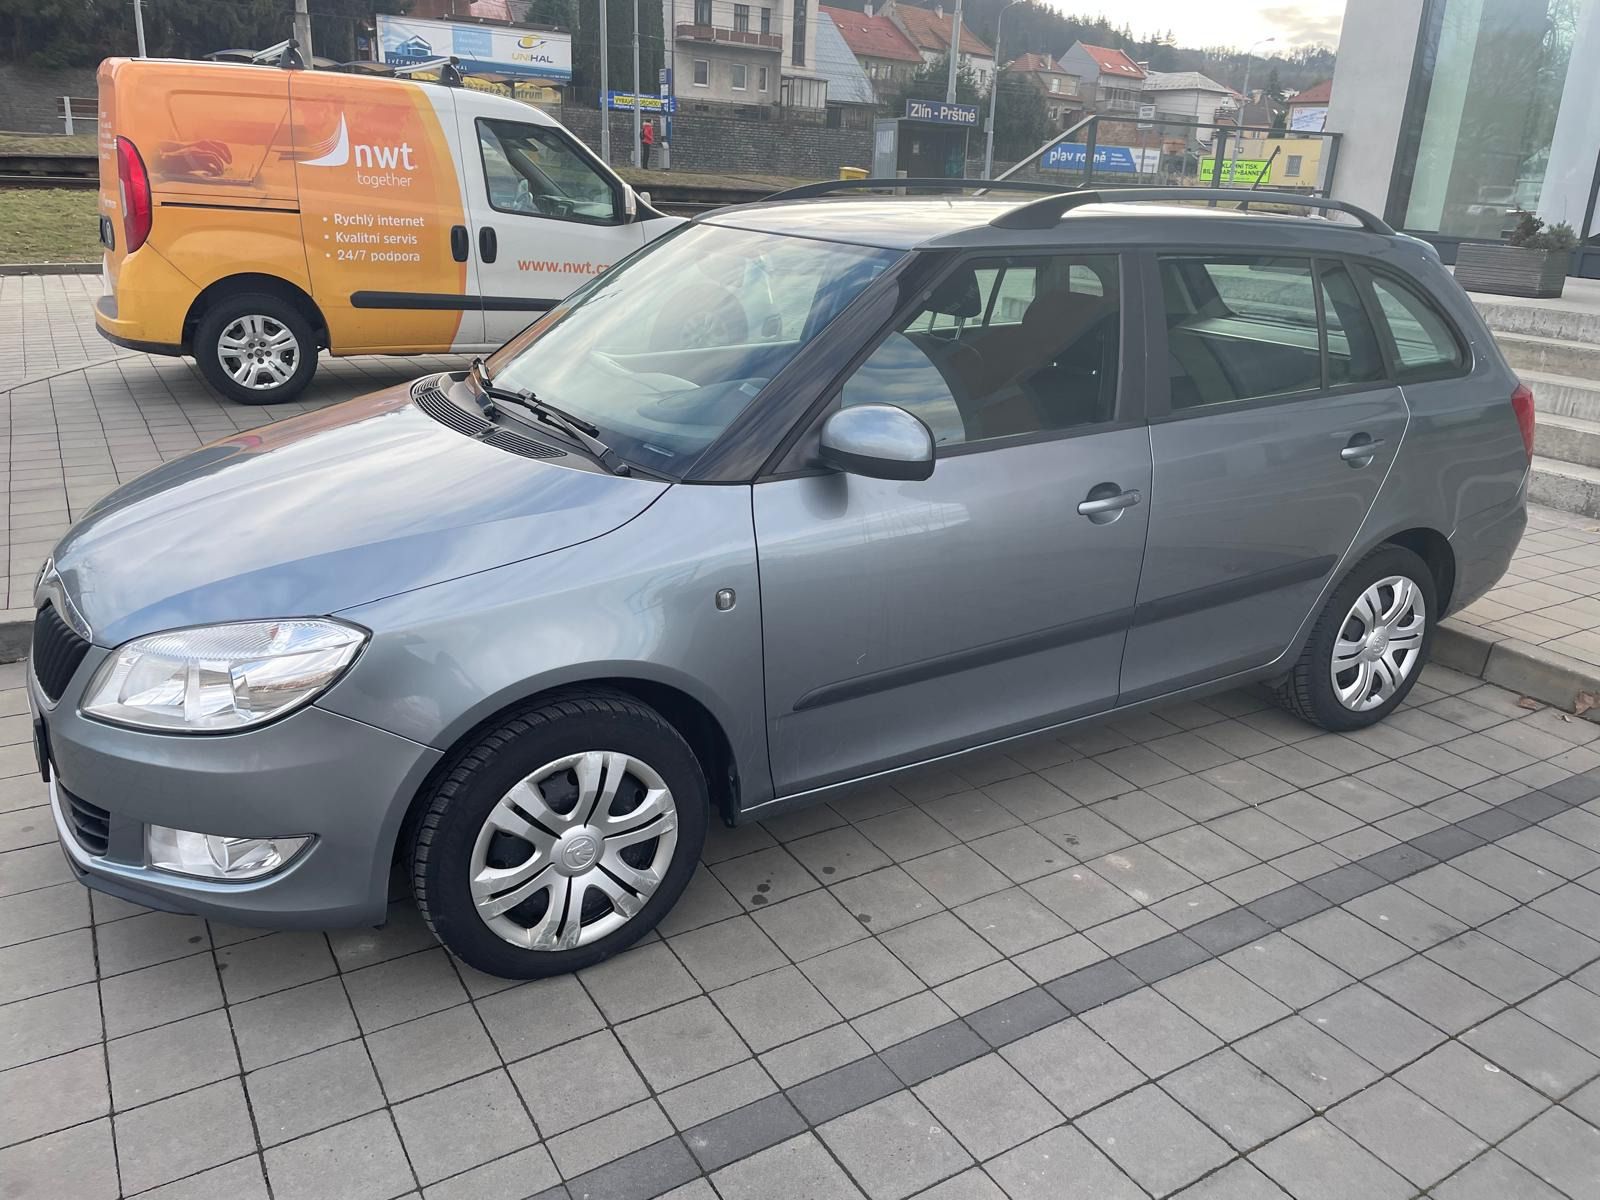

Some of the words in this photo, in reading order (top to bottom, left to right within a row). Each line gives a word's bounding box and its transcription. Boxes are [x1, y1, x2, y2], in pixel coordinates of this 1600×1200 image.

[511, 53, 554, 63] UNIHAL
[910, 103, 932, 118] Zlín
[940, 106, 976, 122] Prštné
[1049, 147, 1074, 165] plav
[1076, 151, 1107, 163] roně
[357, 170, 413, 188] together
[334, 213, 374, 227] Rychlý
[378, 214, 425, 227] internet
[335, 231, 380, 244] Kvalitní
[383, 234, 418, 244] servis
[337, 249, 367, 261] 24/7
[370, 250, 421, 262] podpora
